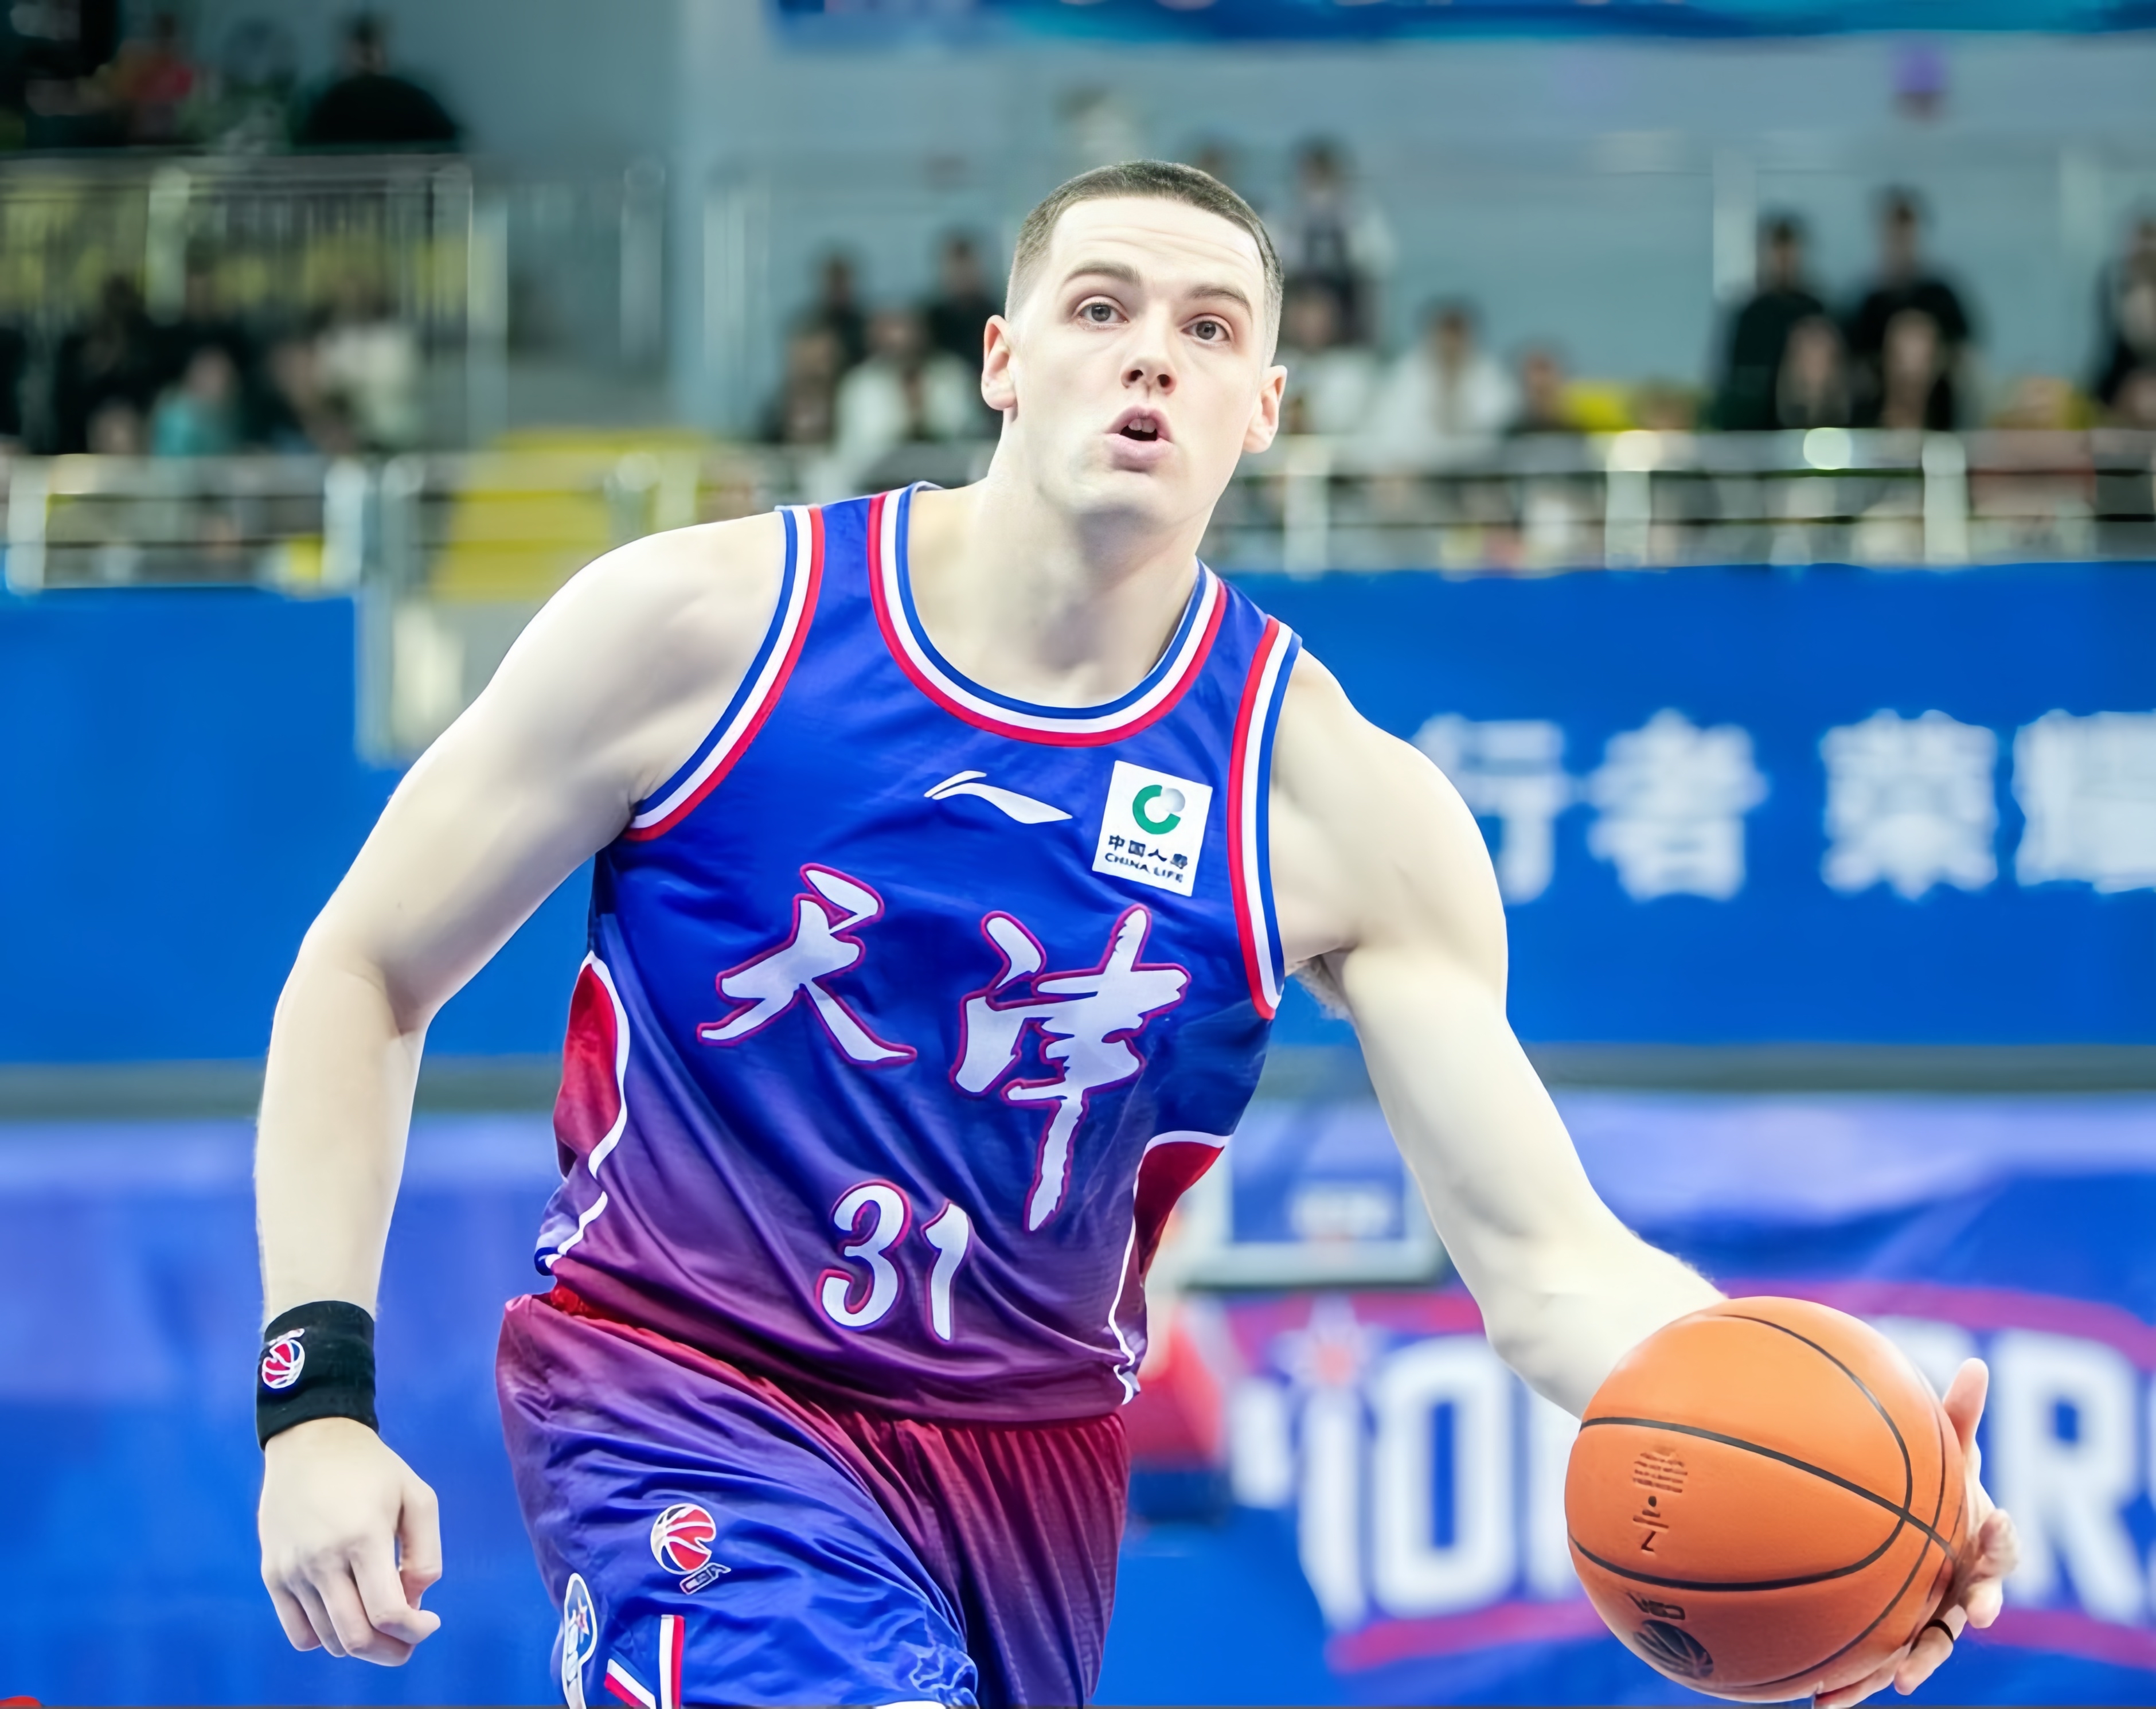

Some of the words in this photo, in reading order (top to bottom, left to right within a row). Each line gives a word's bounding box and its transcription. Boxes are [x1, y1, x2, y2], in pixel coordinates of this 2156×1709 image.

[1105, 853, 1150, 873] CHINA
[1153, 867, 1183, 883] LIFE
[698, 863, 1191, 1232] 天津
[814, 1179, 972, 1344] 31
